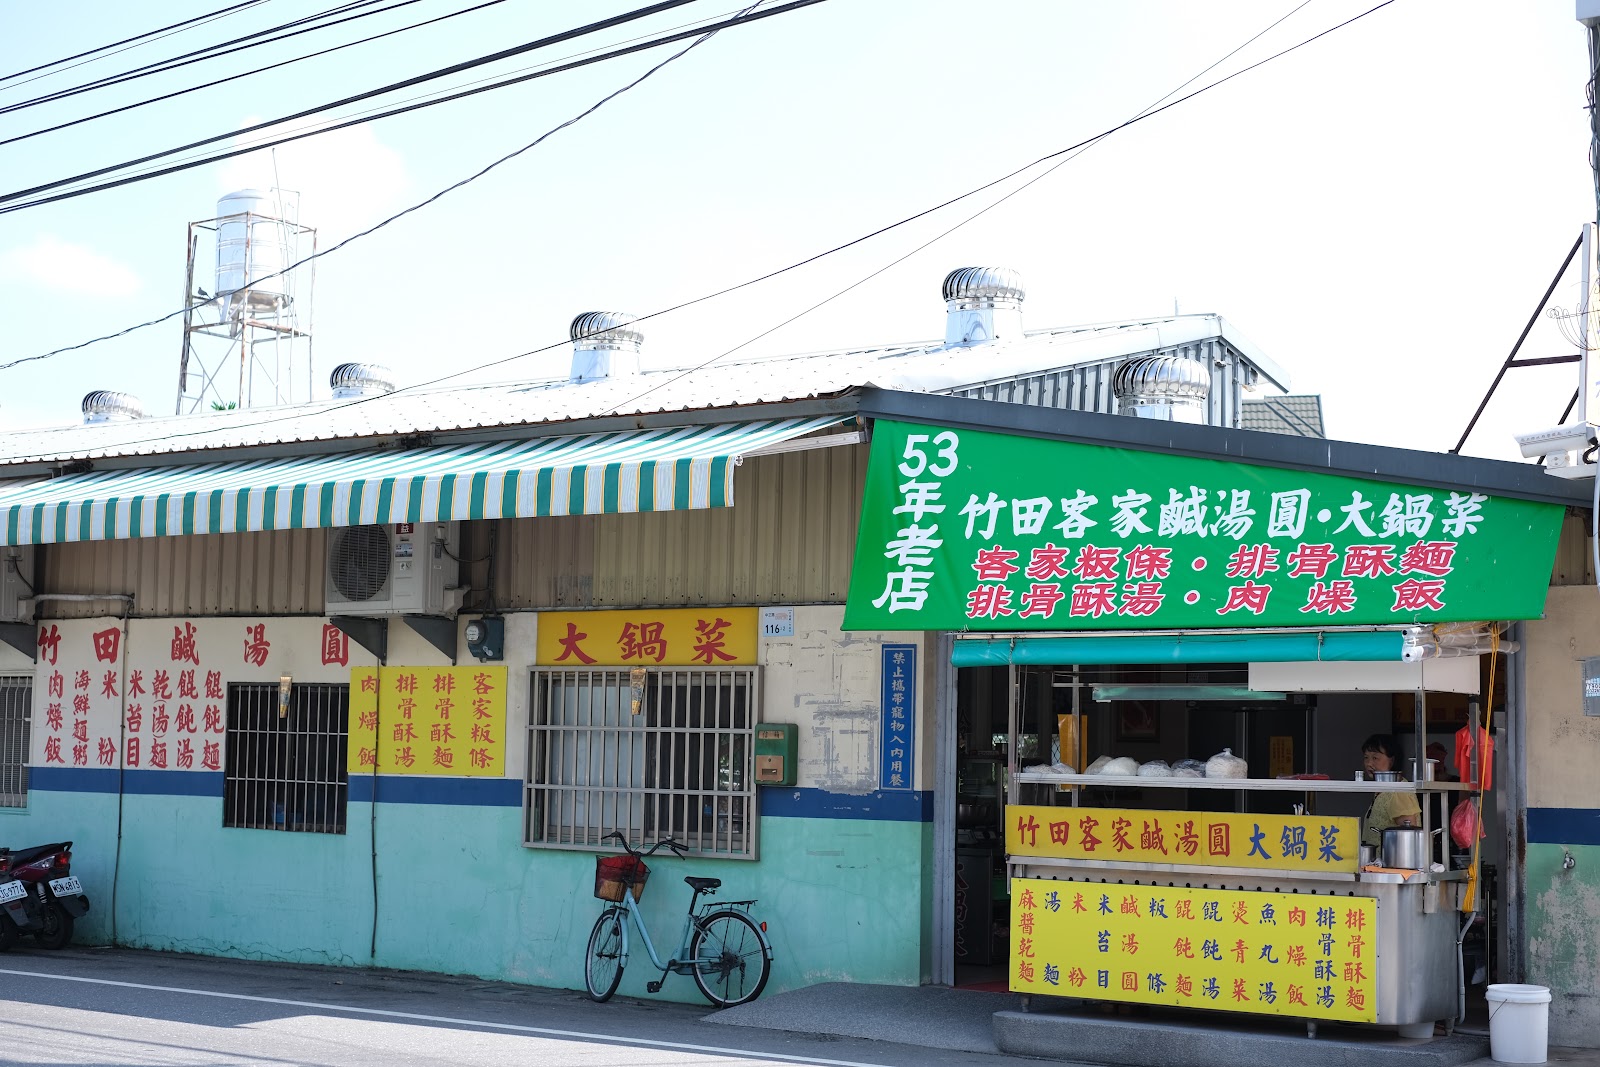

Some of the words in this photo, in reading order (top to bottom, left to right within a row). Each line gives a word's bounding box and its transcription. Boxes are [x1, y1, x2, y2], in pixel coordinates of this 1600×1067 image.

[872, 431, 960, 614] 53年老店
[38, 621, 349, 667] 竹田鹹湯圓
[553, 617, 738, 666] 大鍋菜
[44, 669, 66, 764] 肉燥飯
[72, 670, 91, 765] 海鮮麵粥
[97, 670, 119, 766] 米粉
[127, 670, 146, 767] 米苔目
[174, 669, 199, 769] 餛飩湯
[202, 669, 225, 771] 餛飩麵
[358, 675, 380, 767] 肉燥飯
[393, 674, 417, 767] 排骨酥湯
[431, 673, 455, 769] 排骨酥麵
[469, 672, 494, 769] 客家粄條
[888, 651, 906, 787] 禁止攜帶寵物入內用餐
[1017, 815, 1231, 857] 竹田客家鹹湯圓
[1247, 823, 1344, 863] 大鍋菜
[1019, 888, 1037, 983] 麻醬乾麵
[1095, 895, 1113, 988] 米苔目
[1120, 895, 1141, 992] 鹹湯圓
[1174, 899, 1195, 997] 餛飩麵
[1200, 901, 1223, 999] 餛飩湯
[1231, 901, 1250, 1002] 燙青菜
[1258, 903, 1279, 1004] 魚丸湯
[1287, 906, 1308, 1007] 肉燥飯
[1315, 907, 1337, 1009] 排骨酥湯
[1343, 909, 1367, 1011] 排骨酥麵
